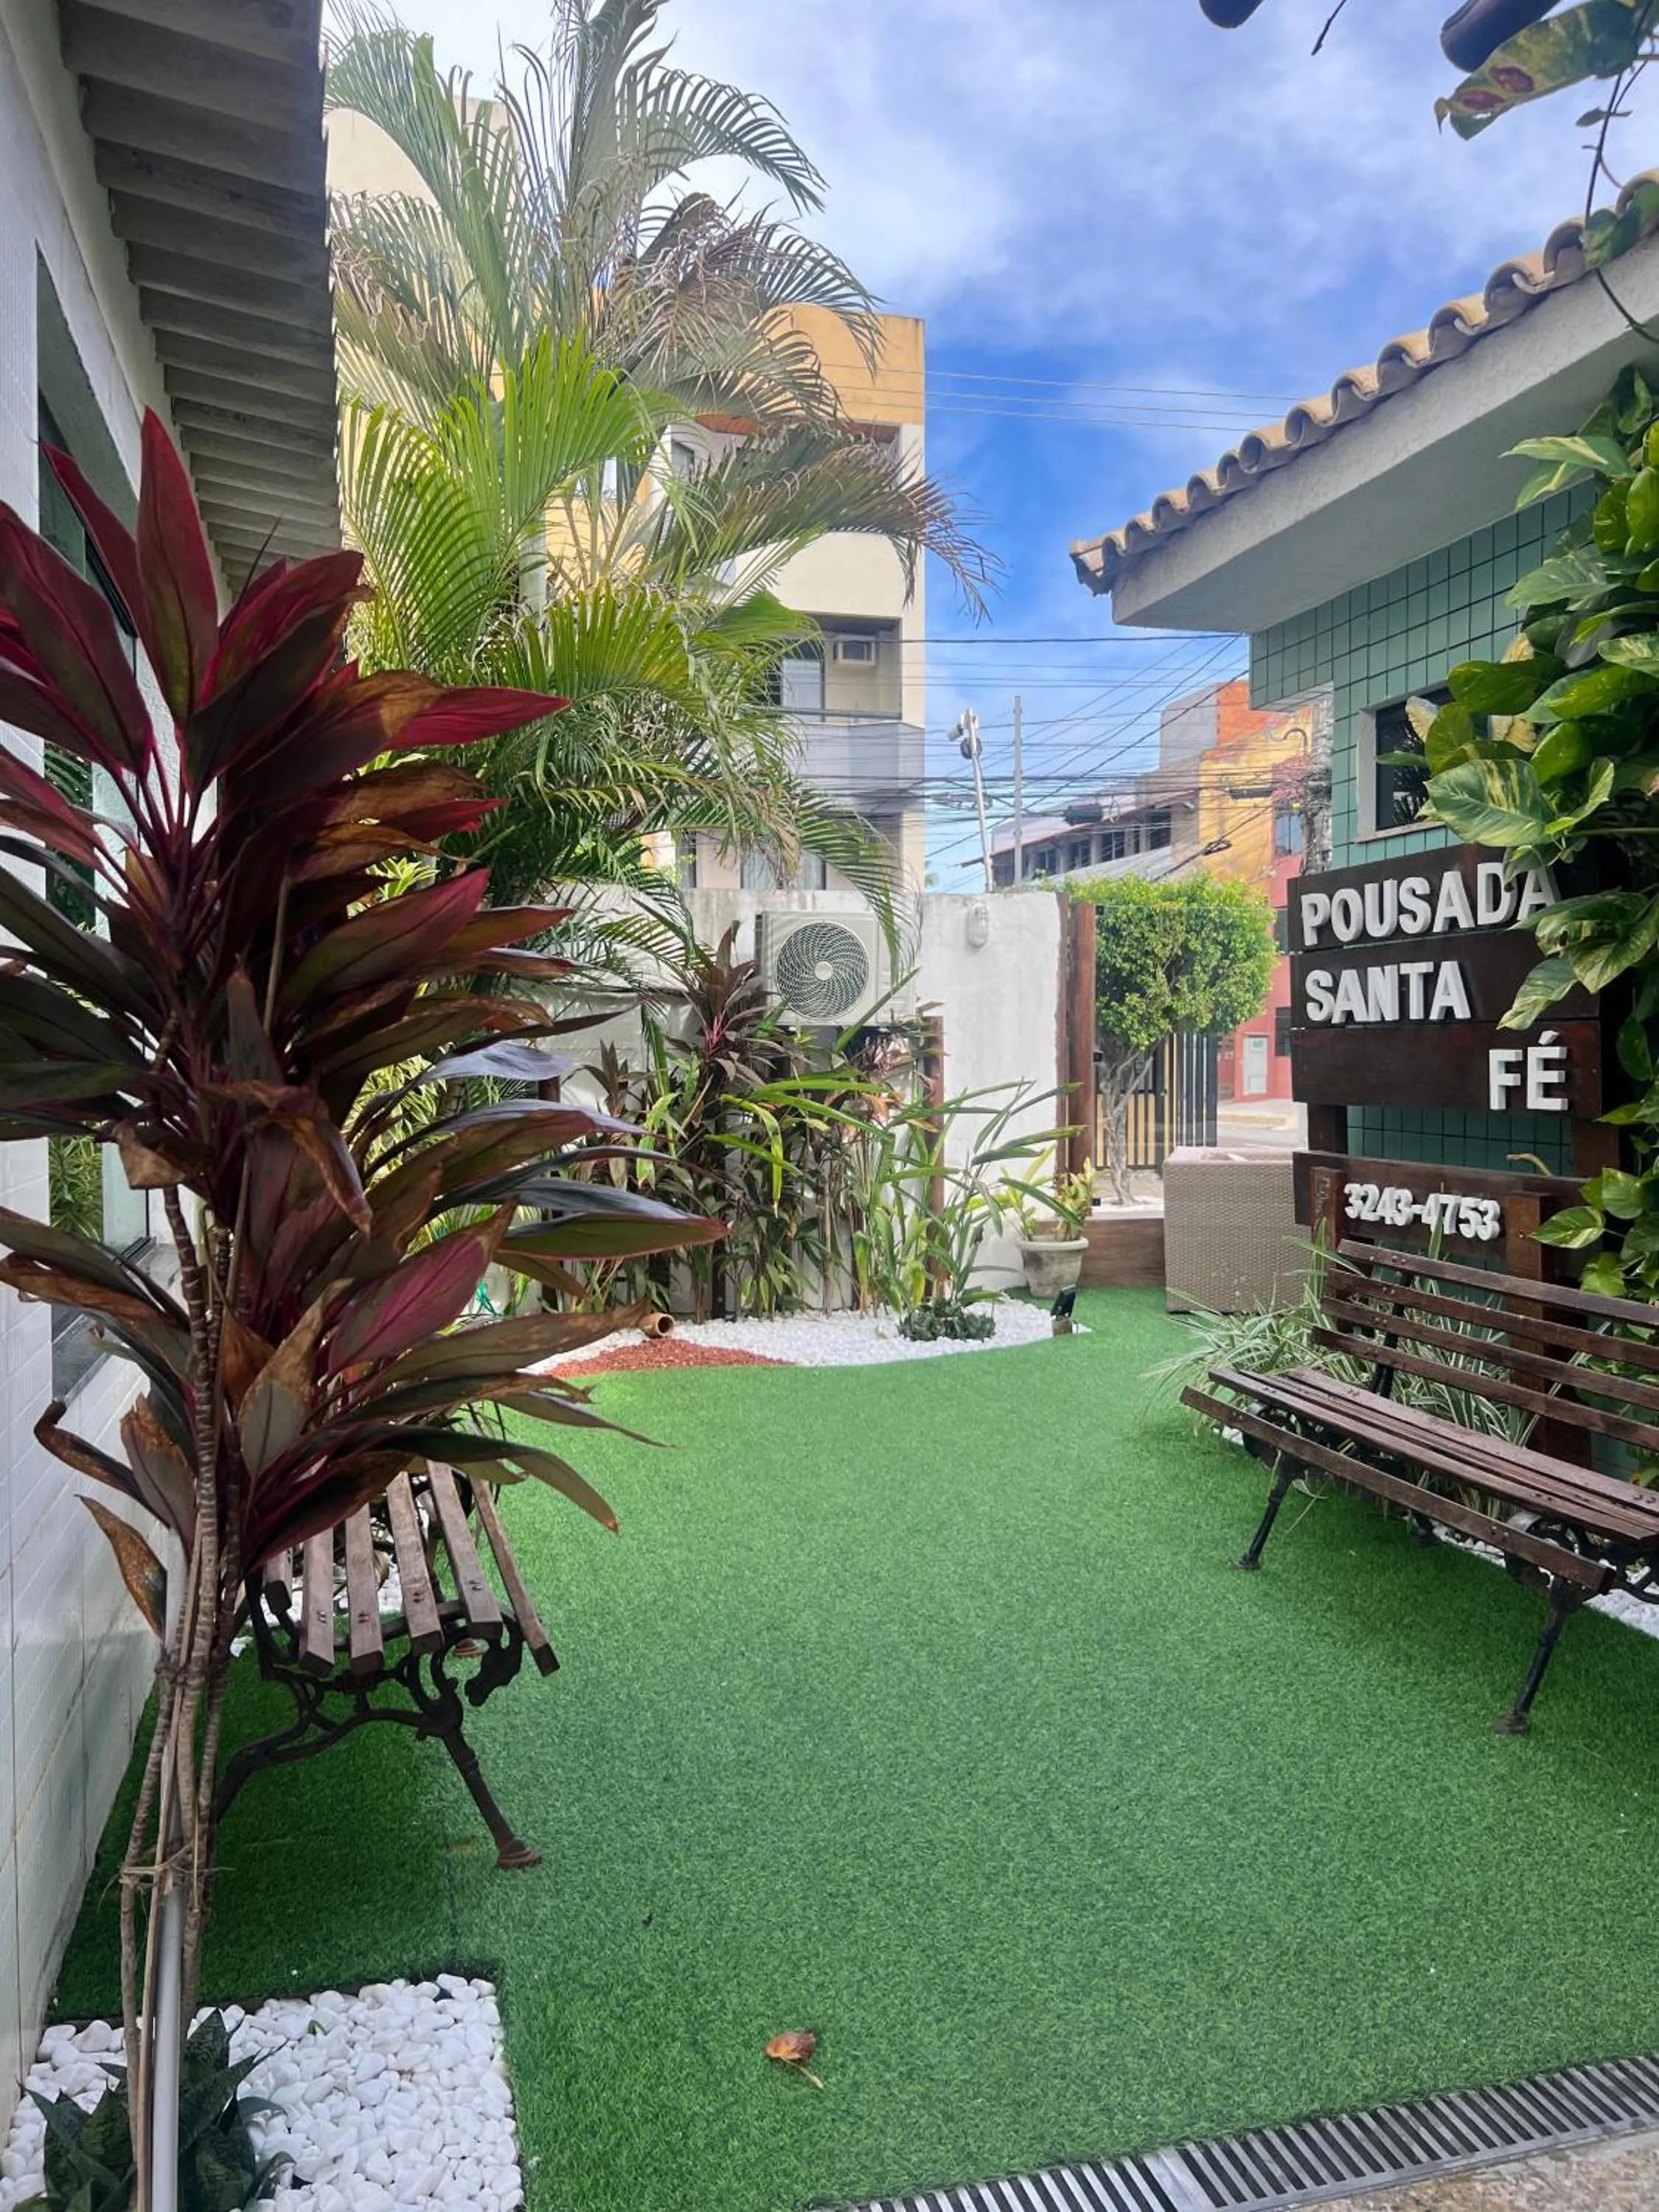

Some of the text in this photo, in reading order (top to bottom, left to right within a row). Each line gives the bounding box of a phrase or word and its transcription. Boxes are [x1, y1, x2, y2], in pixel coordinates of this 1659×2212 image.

[1301, 862, 1561, 946] POUSADA
[1305, 961, 1471, 1024] SANTA
[1489, 1030, 1568, 1110] FÉ
[1343, 1183, 1500, 1241] 3243-4753
